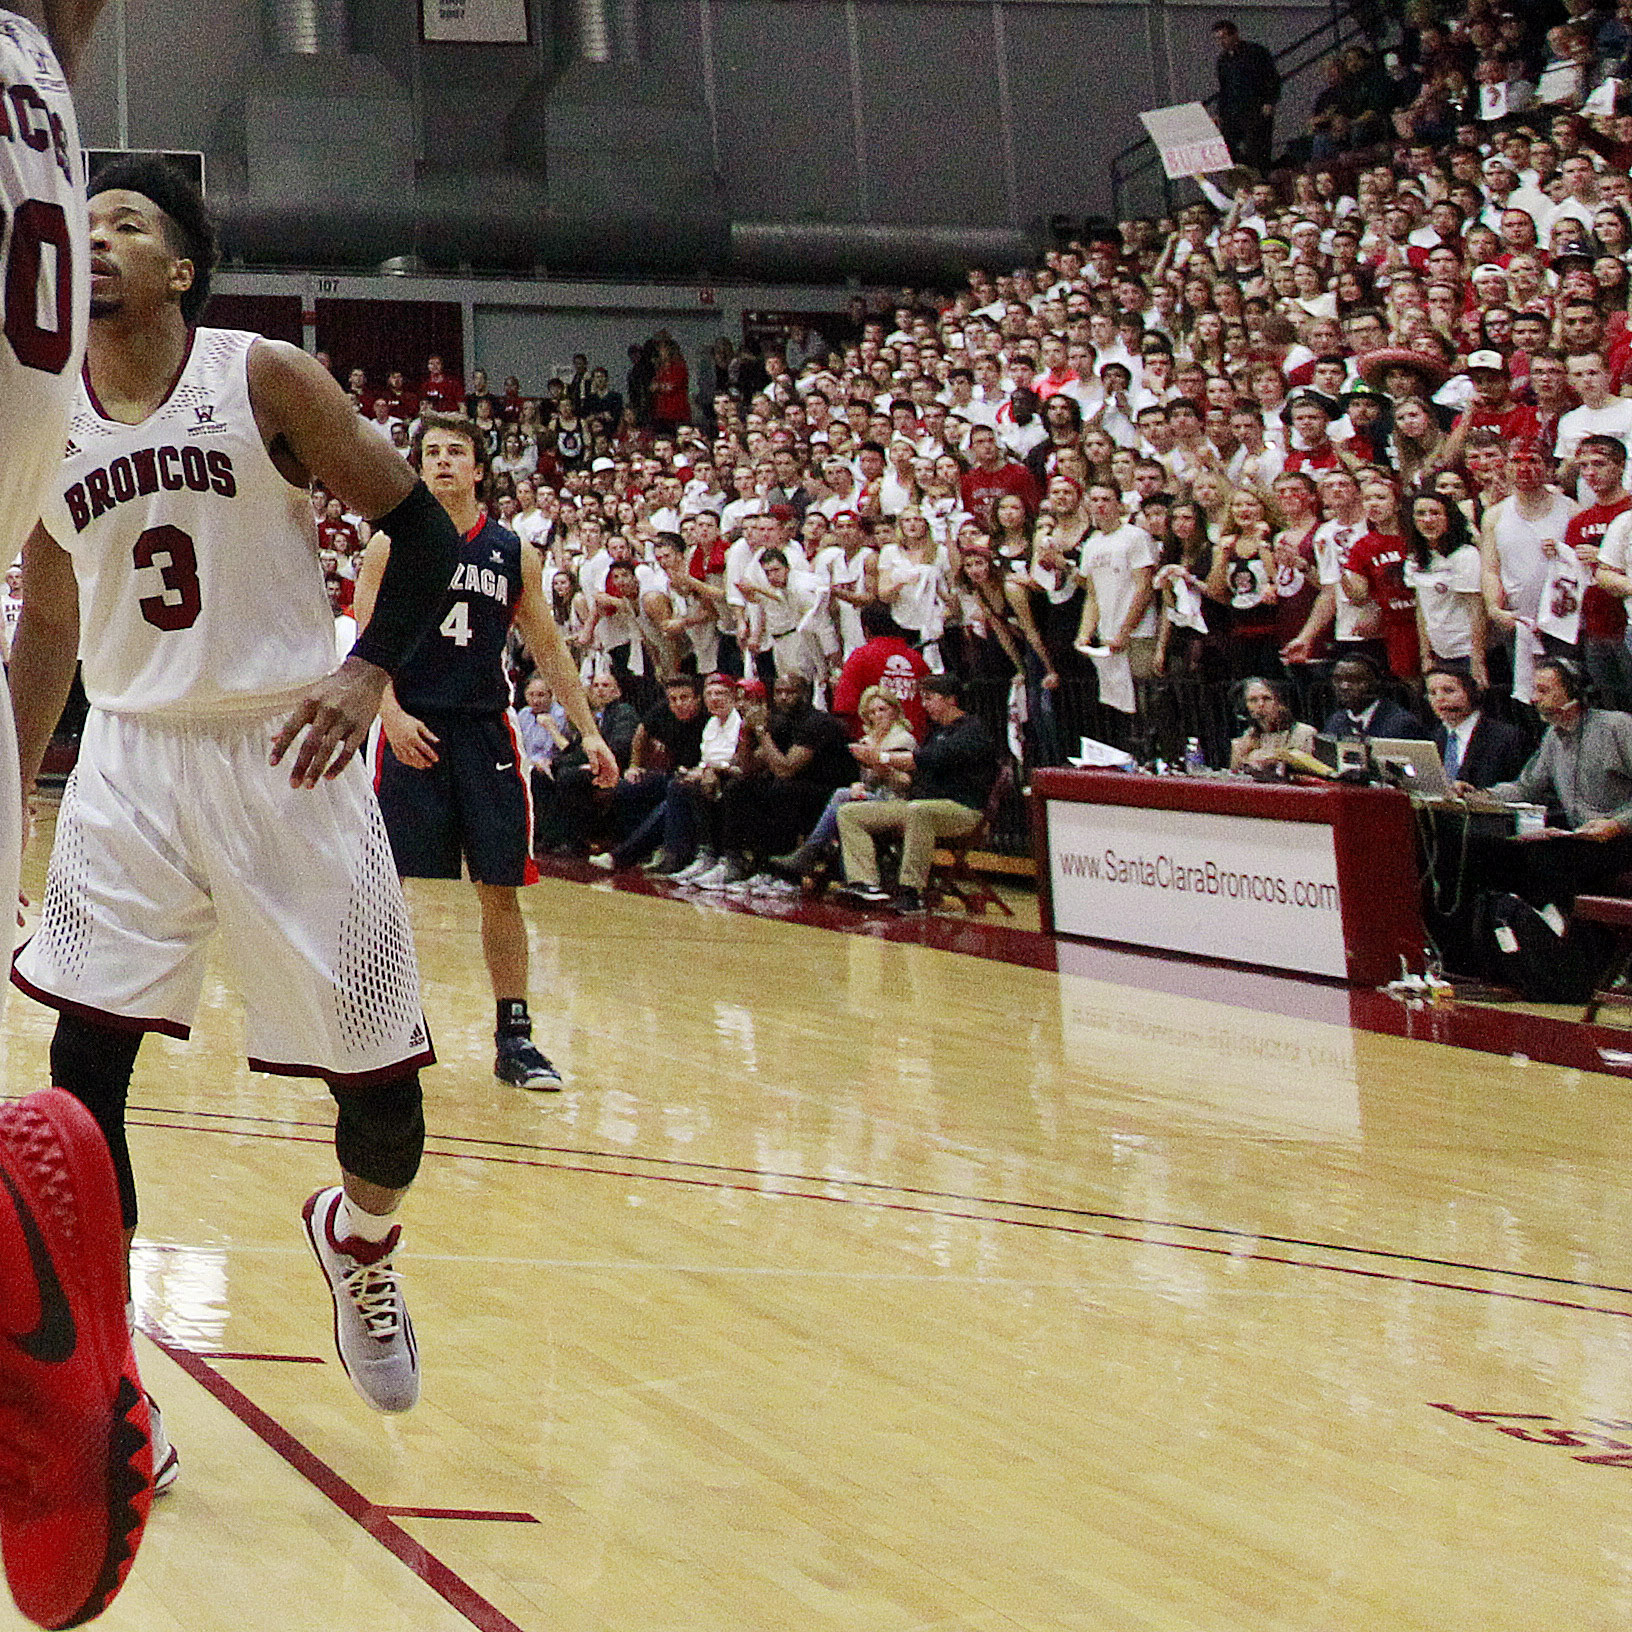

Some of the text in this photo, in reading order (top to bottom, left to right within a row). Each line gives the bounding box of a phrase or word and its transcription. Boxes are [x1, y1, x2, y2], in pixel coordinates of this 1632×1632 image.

[63, 444, 237, 534] BRONCOS
[132, 523, 202, 632] 3
[447, 562, 509, 607] ZAGA
[439, 601, 473, 647] 4
[1059, 847, 1340, 913] www.SantaClaraBroncos.com
